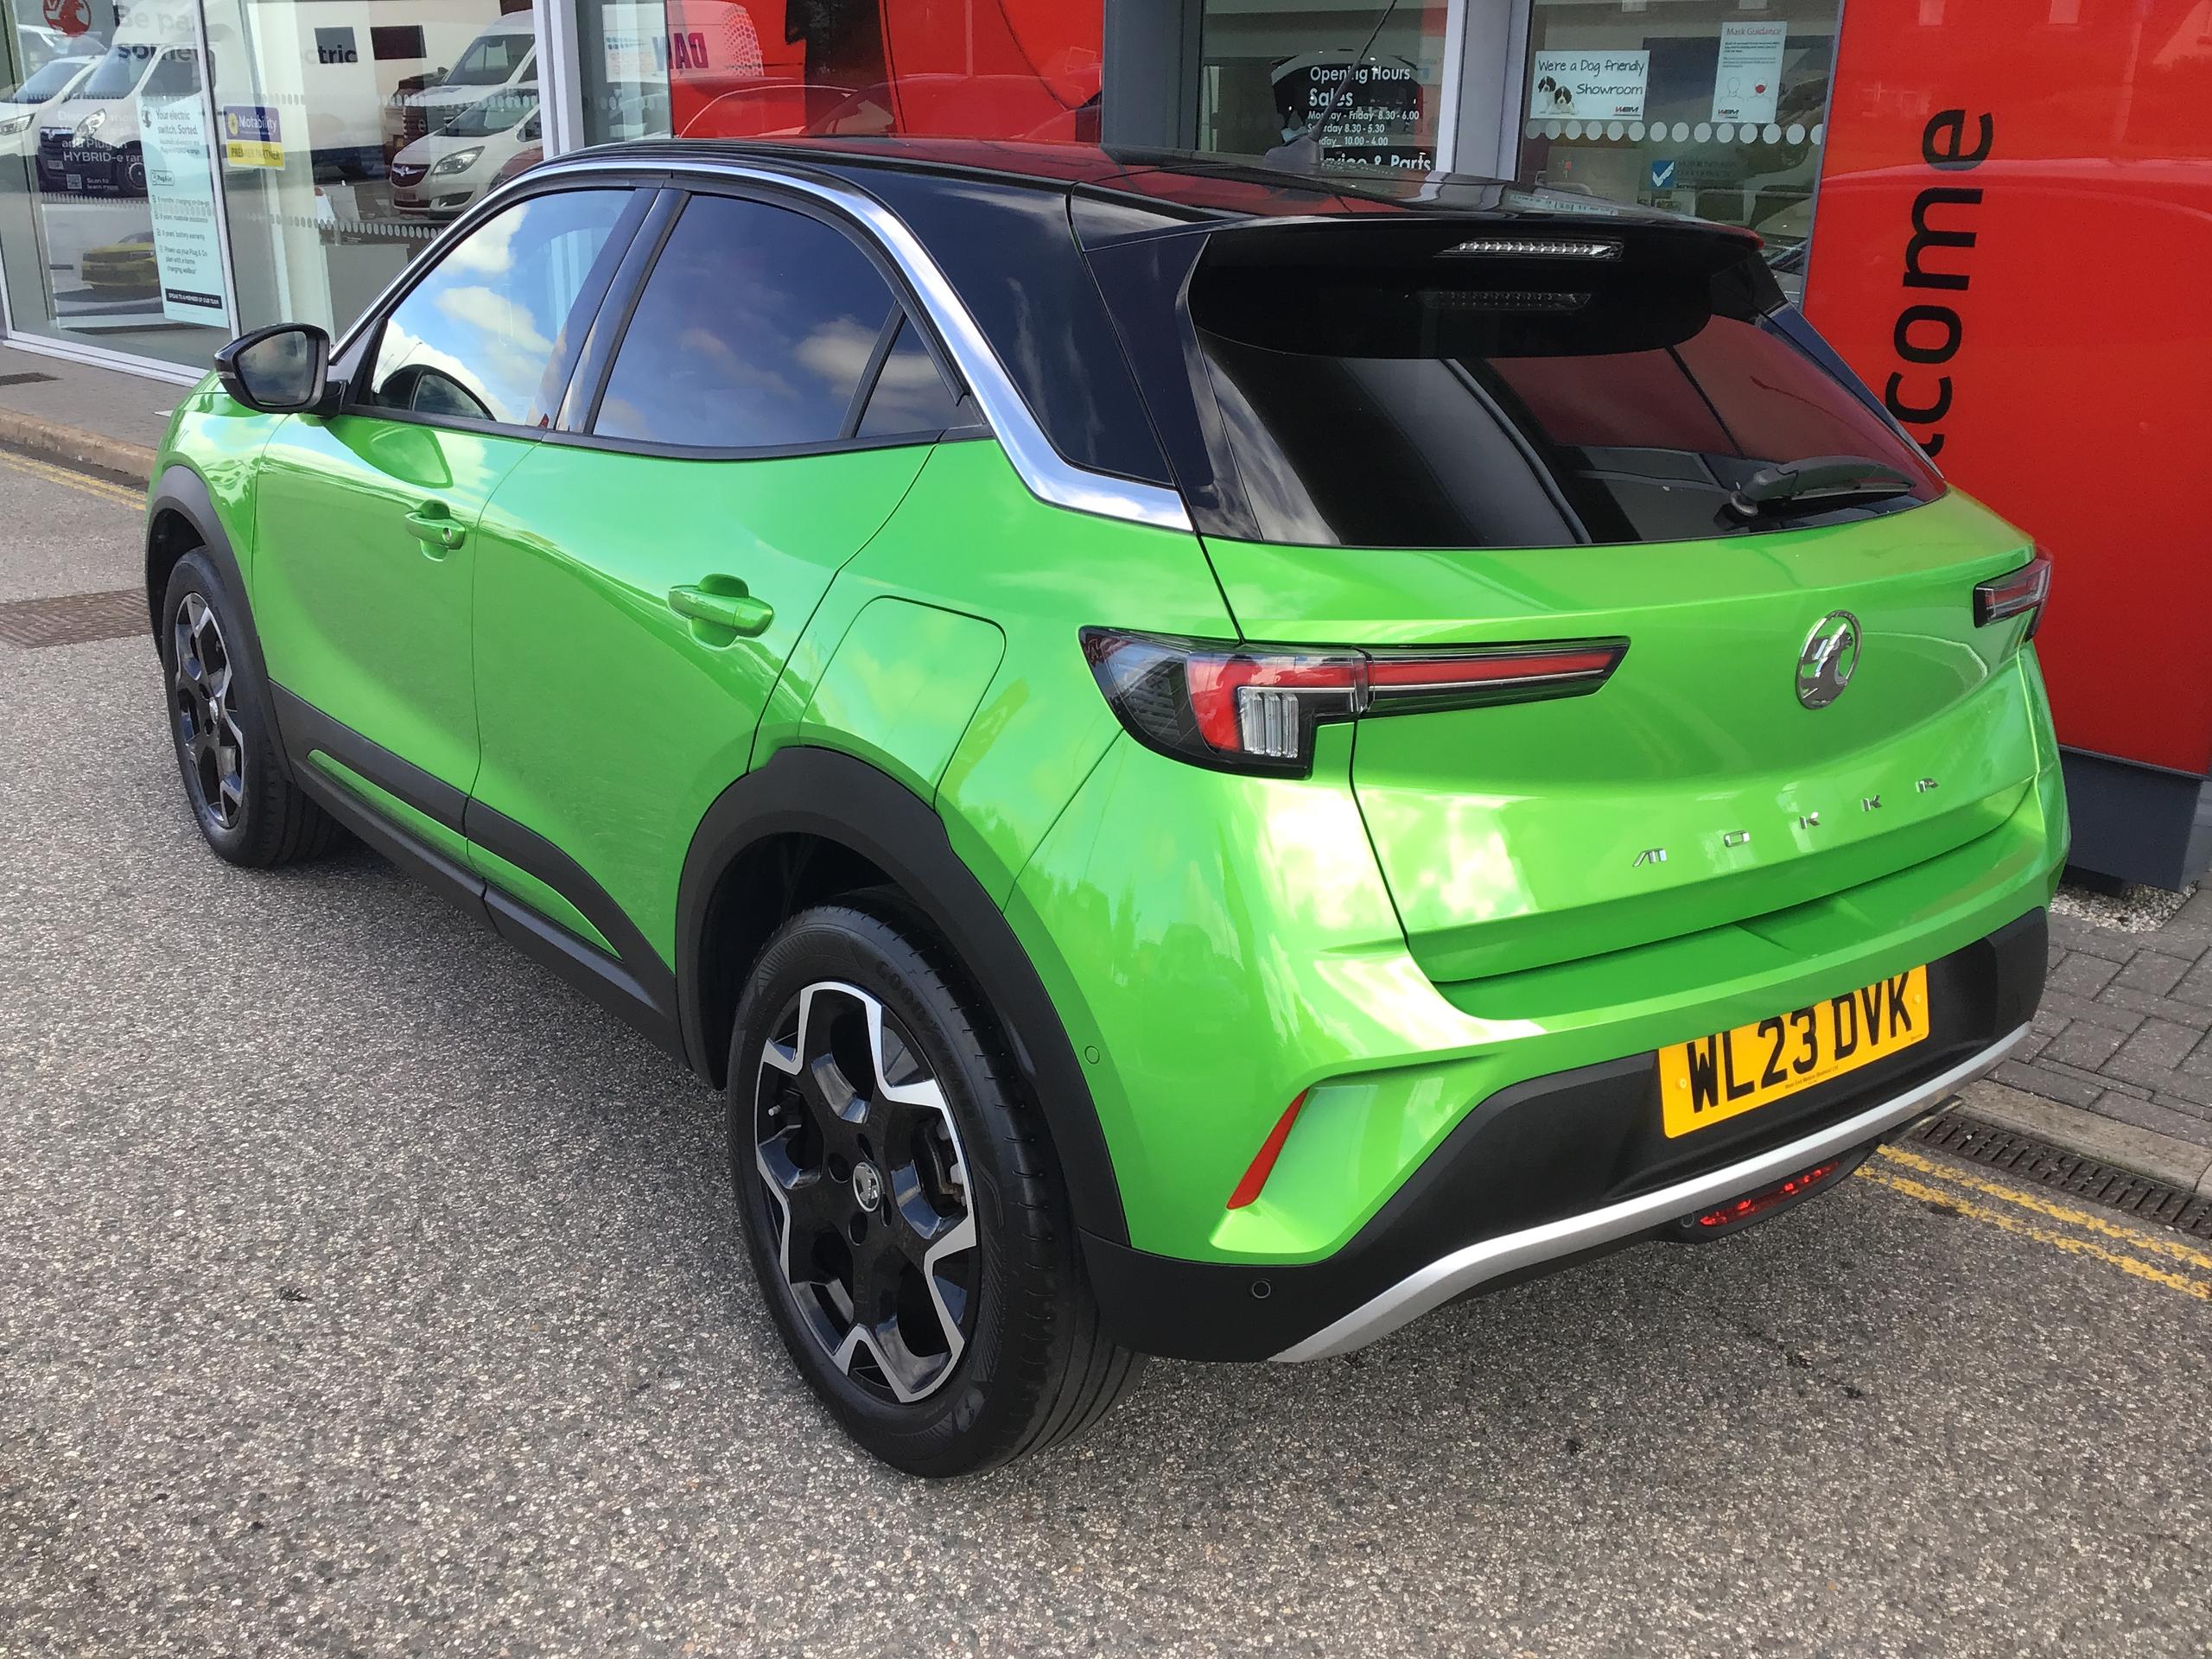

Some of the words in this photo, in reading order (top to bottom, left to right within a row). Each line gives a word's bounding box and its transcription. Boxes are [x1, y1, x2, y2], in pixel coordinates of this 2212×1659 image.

[1372, 66, 1411, 80] Hours
[1538, 60, 1567, 71] We're
[1570, 62, 1577, 71] a
[1580, 60, 1601, 78] Dog
[1605, 60, 1644, 77] friendly
[1575, 83, 1643, 95] Showroom
[1307, 111, 1342, 122] Moay
[1349, 111, 1374, 122] Friday
[1377, 111, 1395, 120] 8.30
[1402, 111, 1420, 120] 6.00
[238, 114, 277, 133] Motability
[1307, 124, 1343, 135] Srday
[1344, 124, 1362, 133] 8.30
[1368, 124, 1385, 133] 5.30
[1344, 137, 1364, 145] 10.00
[1371, 137, 1389, 145] 4.00
[62, 151, 124, 163] HYBRID-e
[1885, 109, 1993, 458] come
[1687, 1006, 1818, 1114] WL23
[1831, 970, 1912, 1061] DVK
